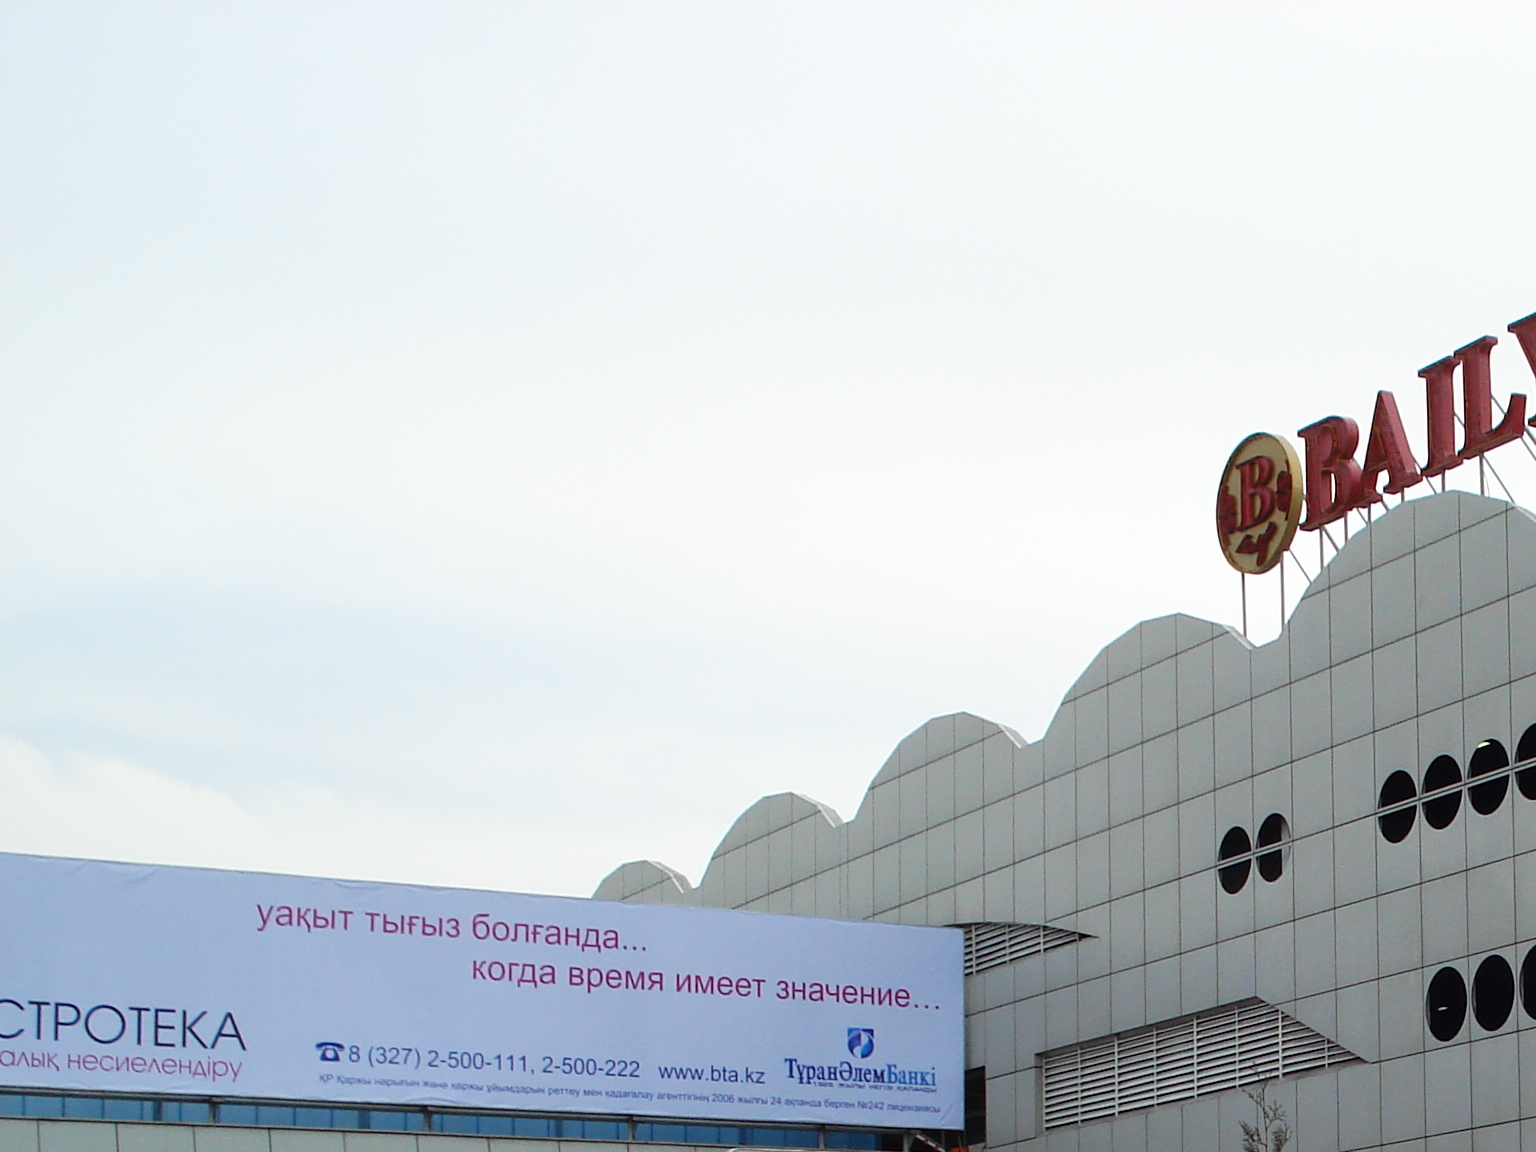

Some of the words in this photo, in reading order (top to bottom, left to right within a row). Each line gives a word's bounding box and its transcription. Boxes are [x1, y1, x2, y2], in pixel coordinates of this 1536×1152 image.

[1235, 455, 1275, 532] B
[256, 903, 354, 933] уақыт
[364, 911, 461, 939] тығыз
[471, 913, 647, 952] болғанда...
[471, 959, 557, 988] когда
[567, 965, 664, 994] время
[675, 972, 766, 998] имеет
[775, 979, 941, 1010] значение...
[67, 1053, 243, 1083] несиелендіру
[349, 1045, 361, 1063] 8
[368, 1046, 421, 1070] (327)
[427, 1050, 535, 1075] 2-500-111,
[542, 1056, 640, 1078] 2-500-222
[658, 1064, 766, 1085] www.bta.kz
